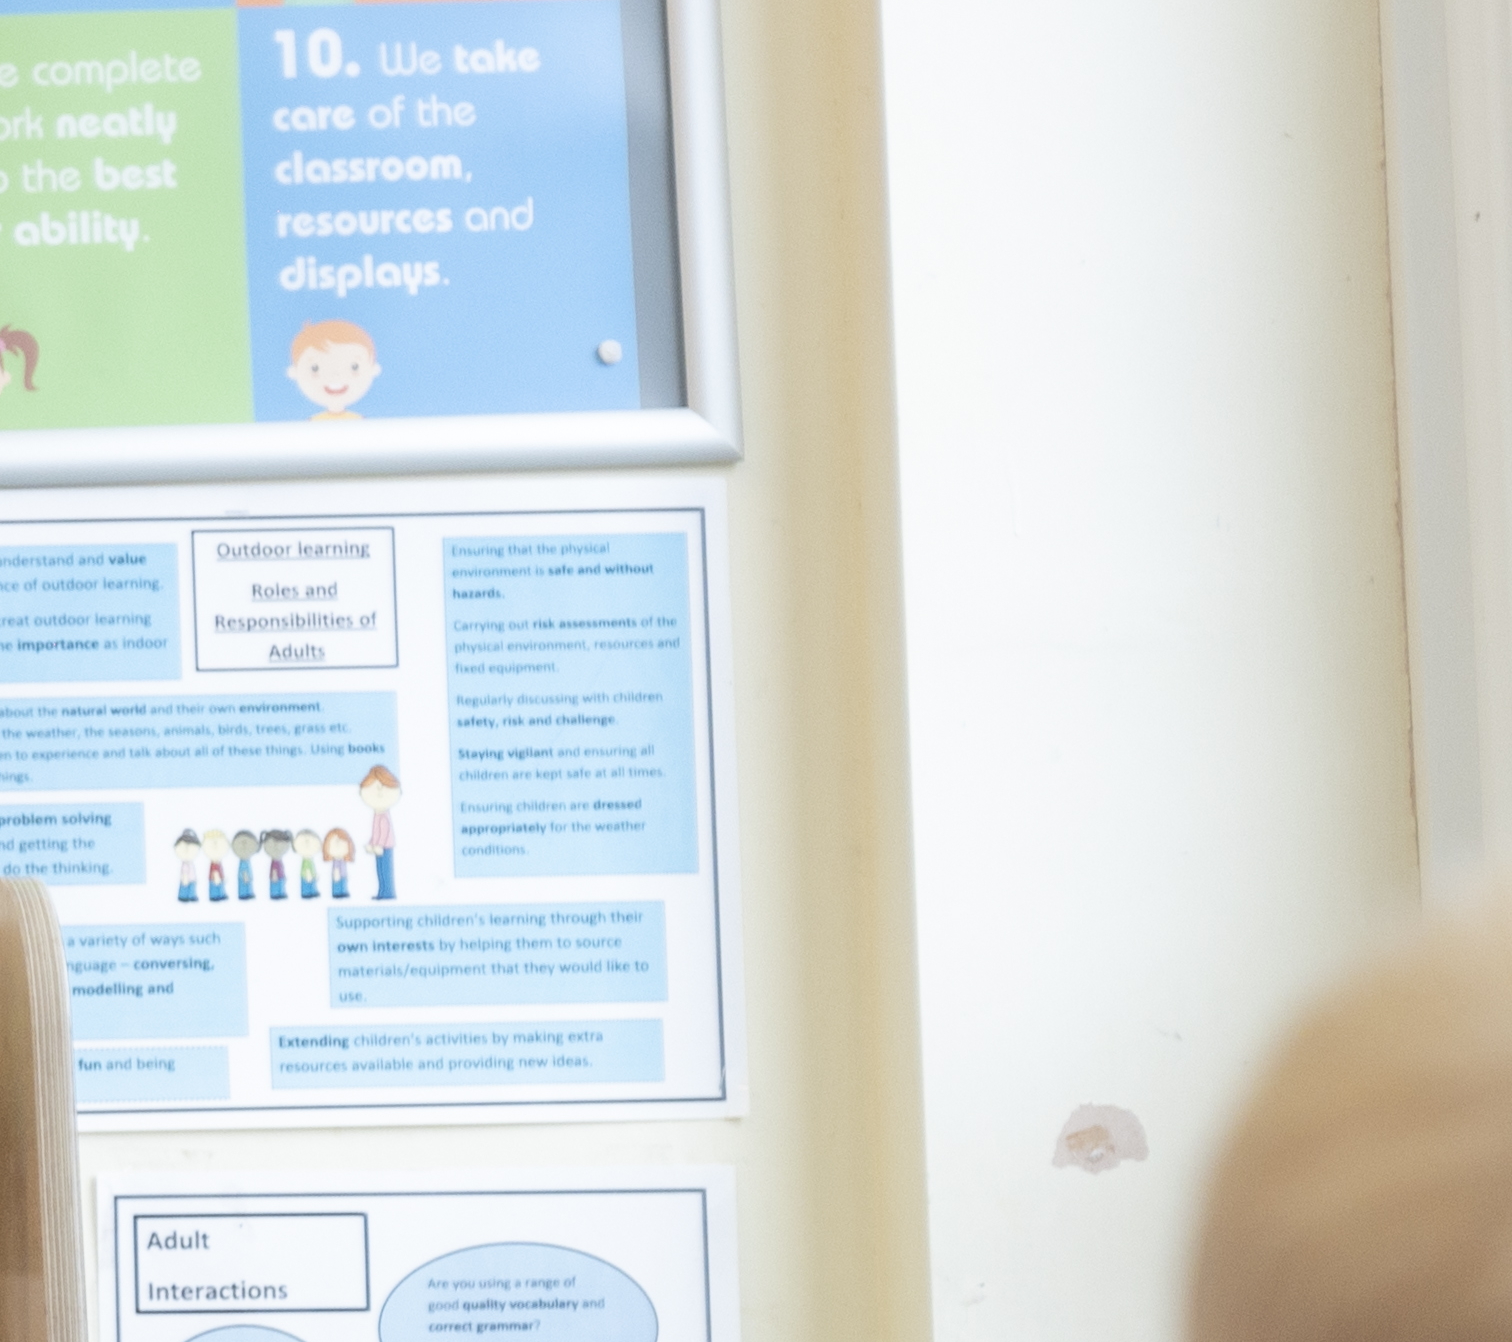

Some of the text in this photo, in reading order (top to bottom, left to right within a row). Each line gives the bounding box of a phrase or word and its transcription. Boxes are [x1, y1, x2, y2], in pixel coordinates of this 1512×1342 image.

[273, 26, 542, 78] 10. We take
[272, 92, 477, 131] care of the
[273, 150, 472, 185] classroom,
[276, 195, 534, 238] resources and
[278, 253, 450, 298] displays.
[216, 539, 370, 559] Outdoor learning
[252, 581, 338, 600] Roles and
[214, 610, 378, 632] Responsibilities of
[268, 642, 326, 661] Adults
[60, 811, 112, 827] solving
[17, 838, 68, 854] getting
[71, 837, 95, 849] the
[147, 1230, 210, 1252] Adult
[147, 1278, 290, 1303] Interactions
